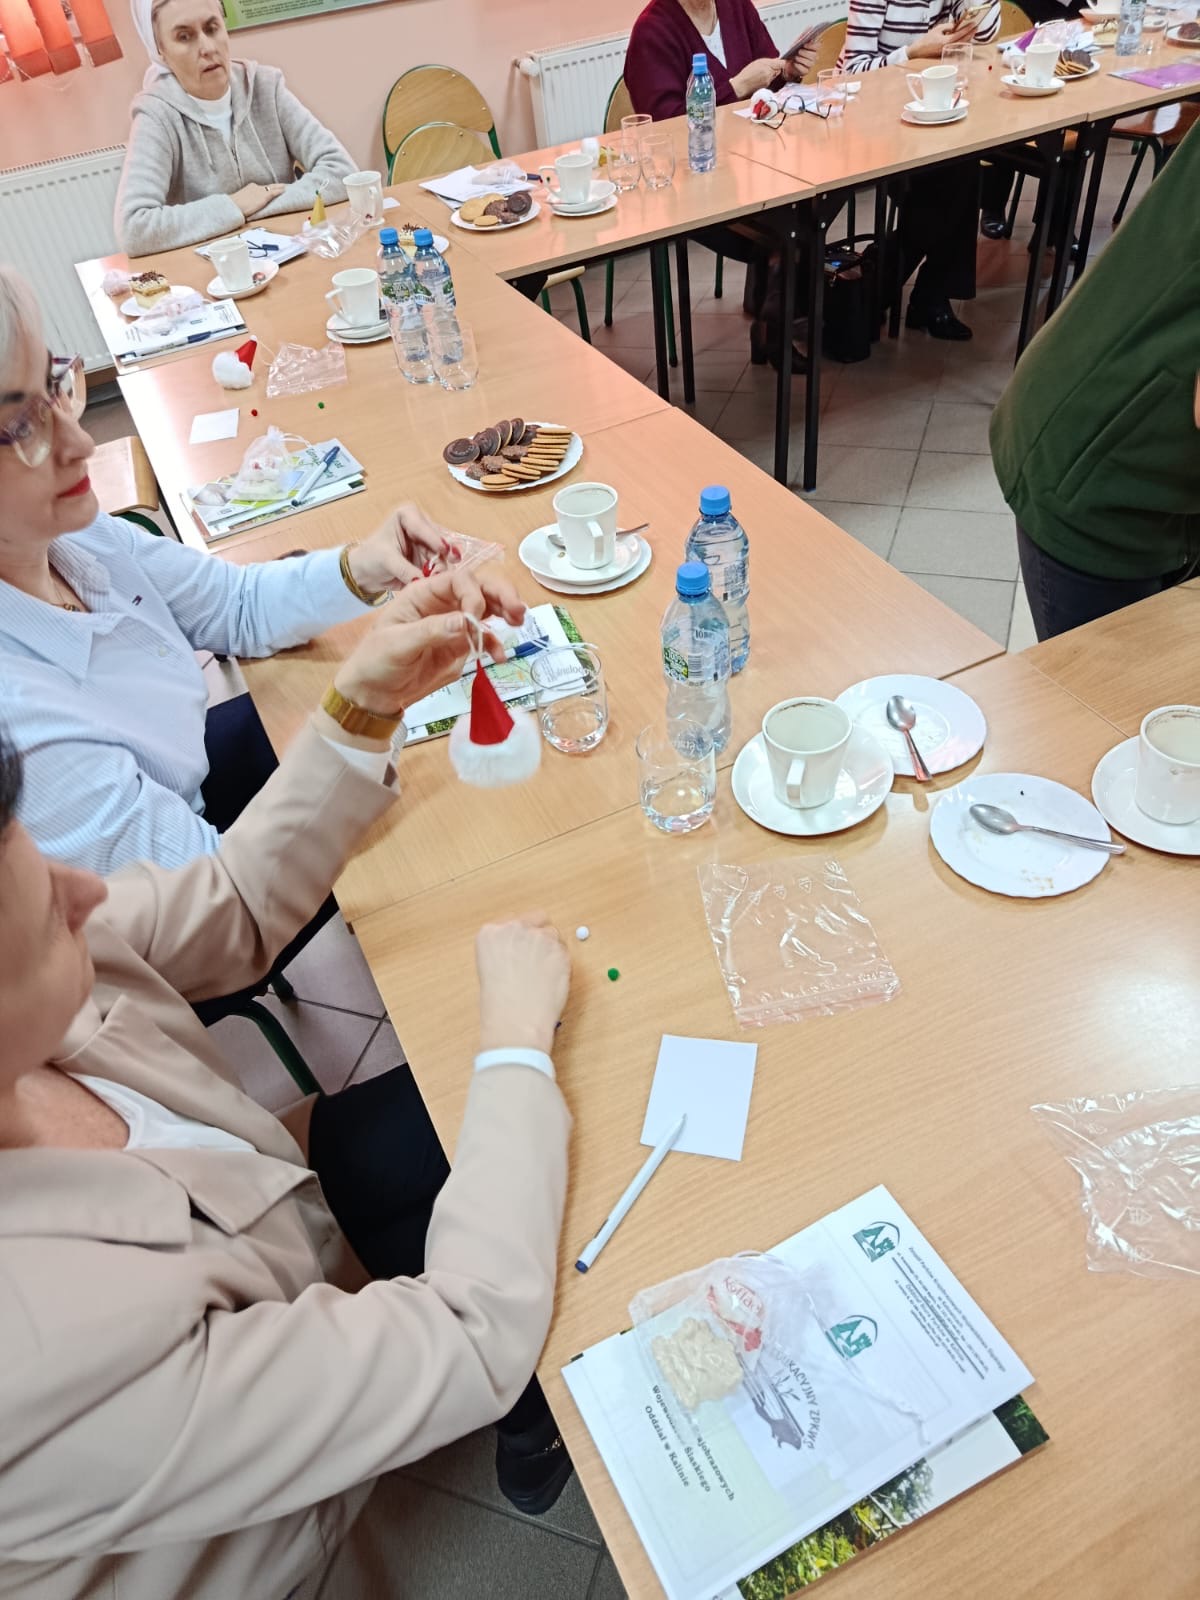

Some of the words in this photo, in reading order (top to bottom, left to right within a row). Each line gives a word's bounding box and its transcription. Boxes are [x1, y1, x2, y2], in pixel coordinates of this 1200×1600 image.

[643, 1404, 667, 1441] Oddział
[662, 1441, 671, 1451] w
[667, 1451, 691, 1487] Kalinie
